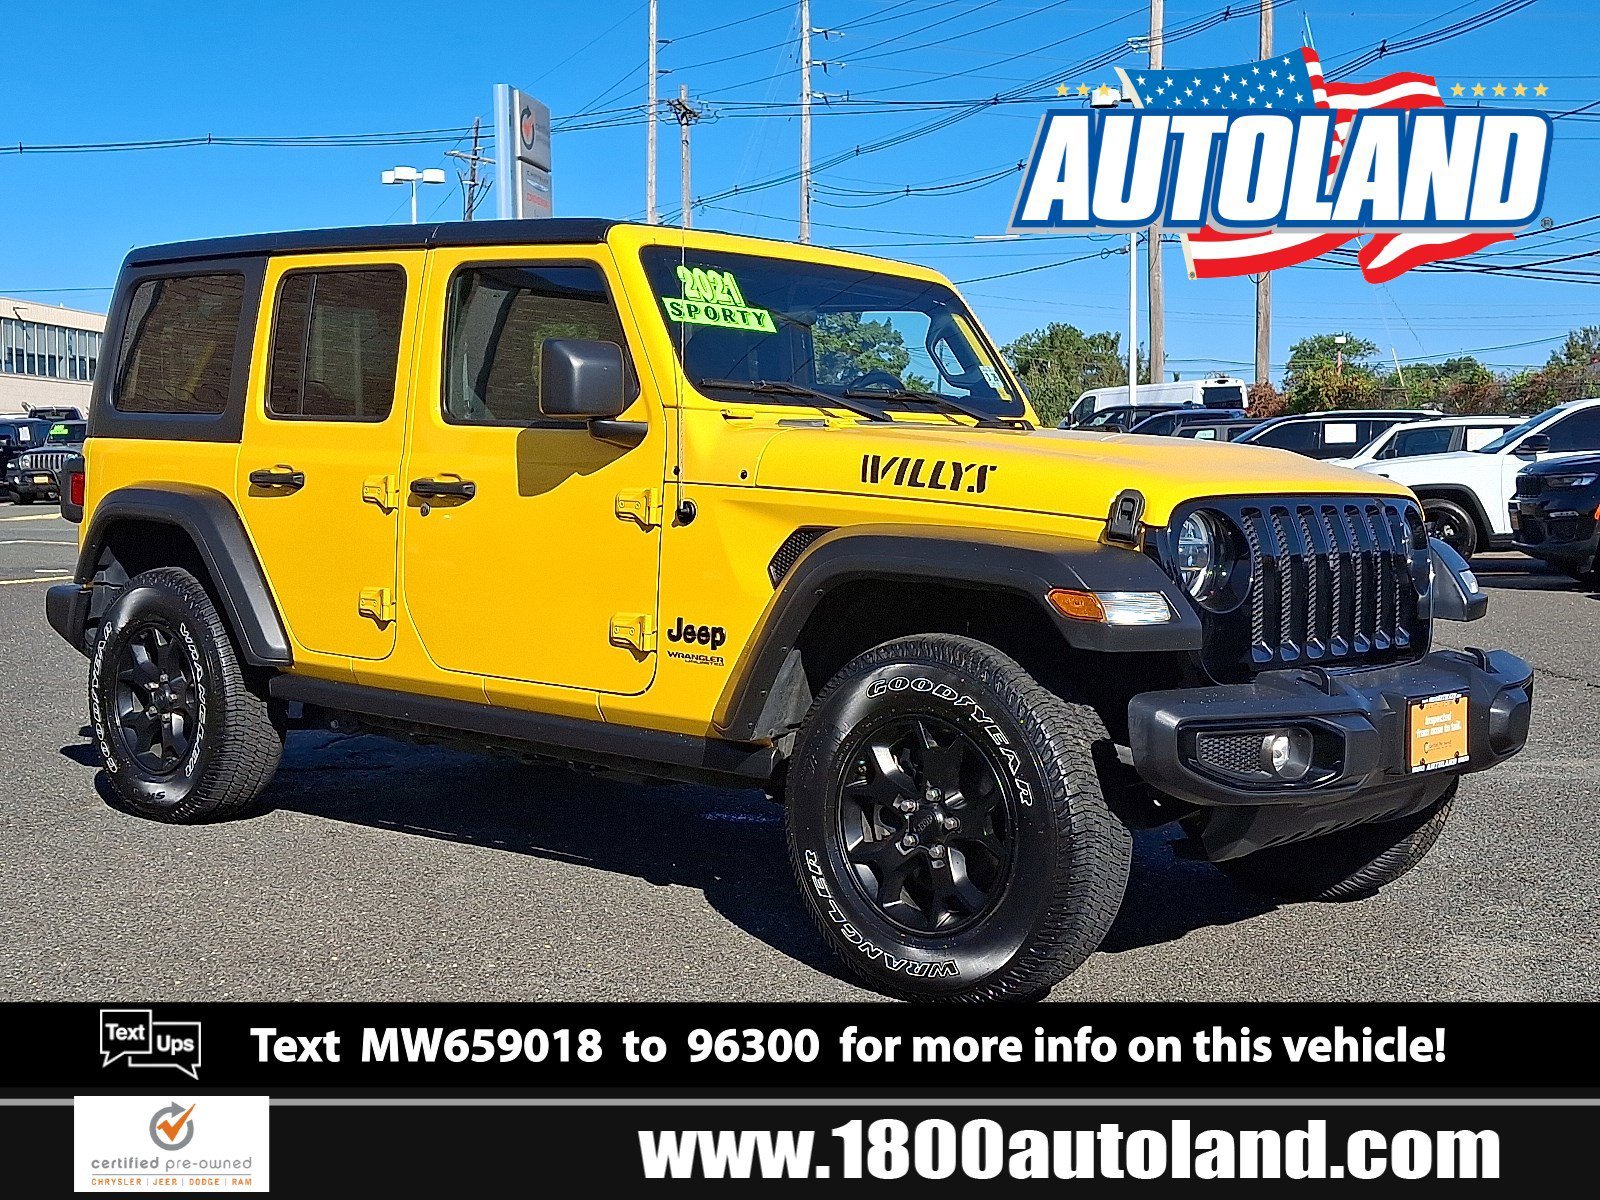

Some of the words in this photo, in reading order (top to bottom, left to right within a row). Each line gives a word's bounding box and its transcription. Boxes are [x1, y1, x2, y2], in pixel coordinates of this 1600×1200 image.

[676, 265, 746, 307] 2021
[669, 301, 766, 327] SPORTY
[861, 454, 997, 494] WILLYS
[667, 616, 727, 651] Jeep
[667, 650, 725, 664] WRANGLER
[865, 675, 1034, 807] GOODYEAR
[804, 849, 960, 978] WRANGLER
